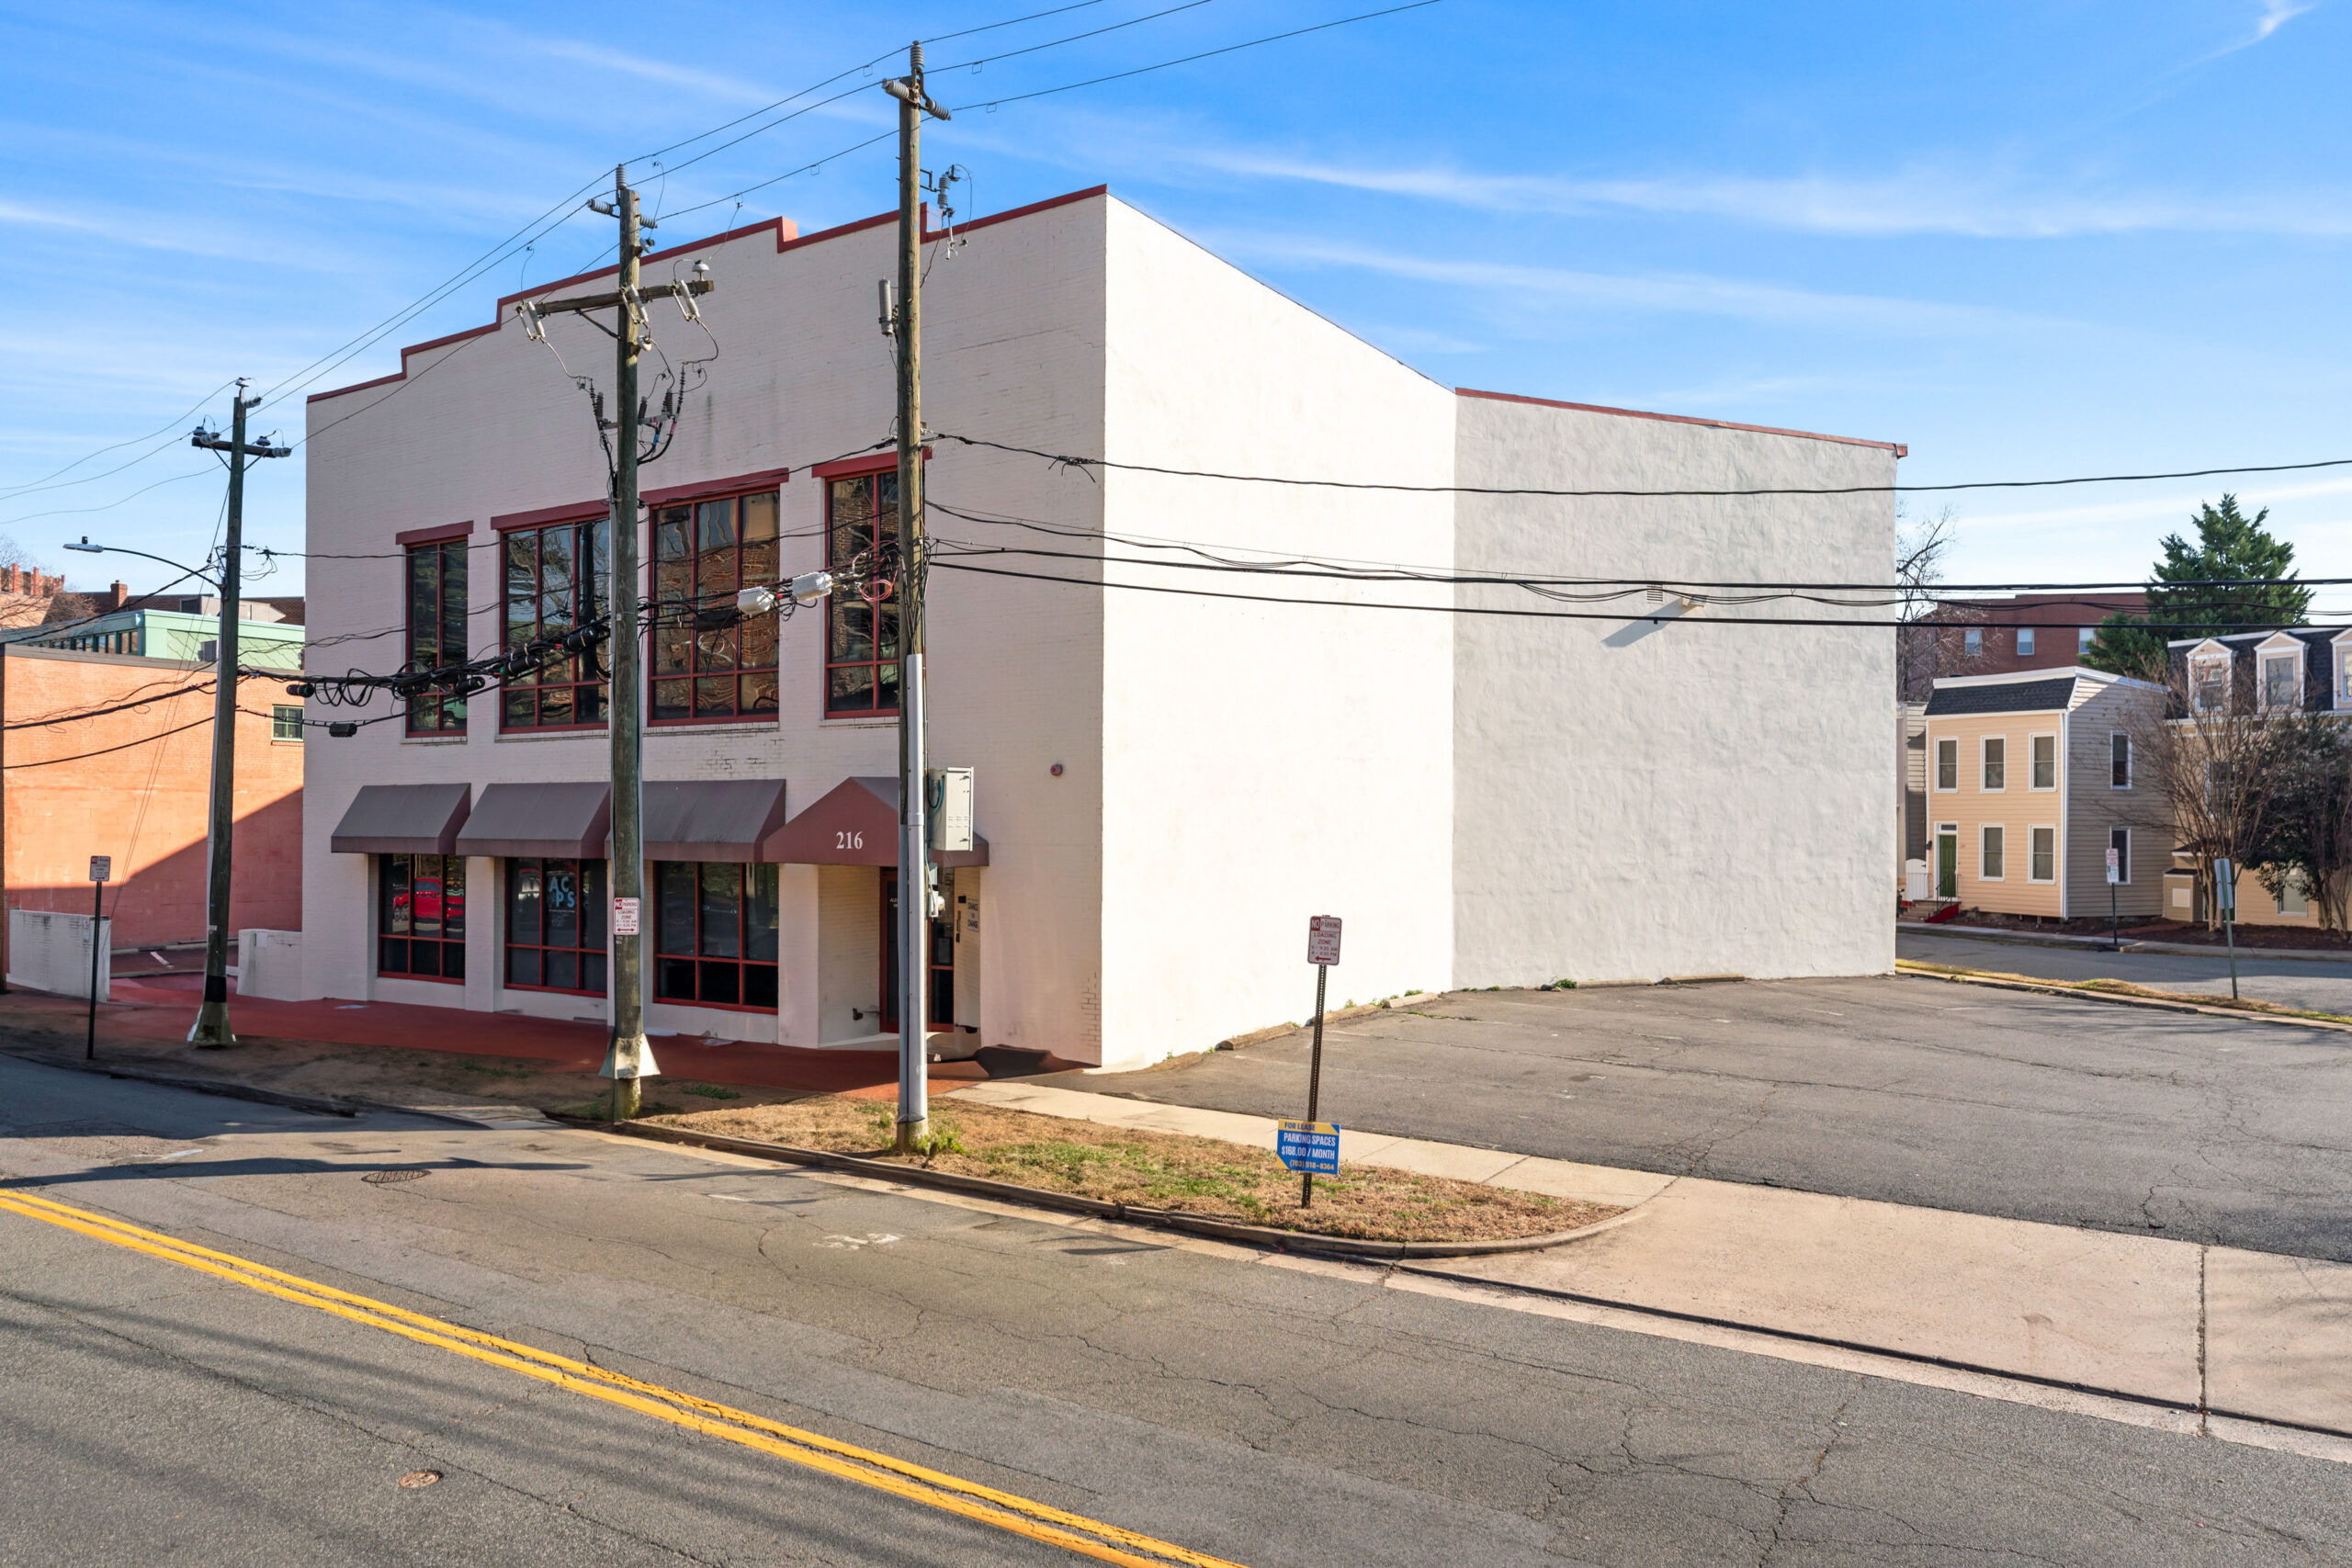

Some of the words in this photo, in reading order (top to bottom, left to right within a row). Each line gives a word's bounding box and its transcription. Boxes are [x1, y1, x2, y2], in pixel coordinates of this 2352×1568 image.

[836, 831, 863, 850] 216
[1311, 919, 1320, 929] NO
[1320, 919, 1340, 930] PARKING
[1283, 1132, 1311, 1145] PARKING
[1311, 1134, 1336, 1146] SPACES
[1312, 1148, 1335, 1160] MONTH
